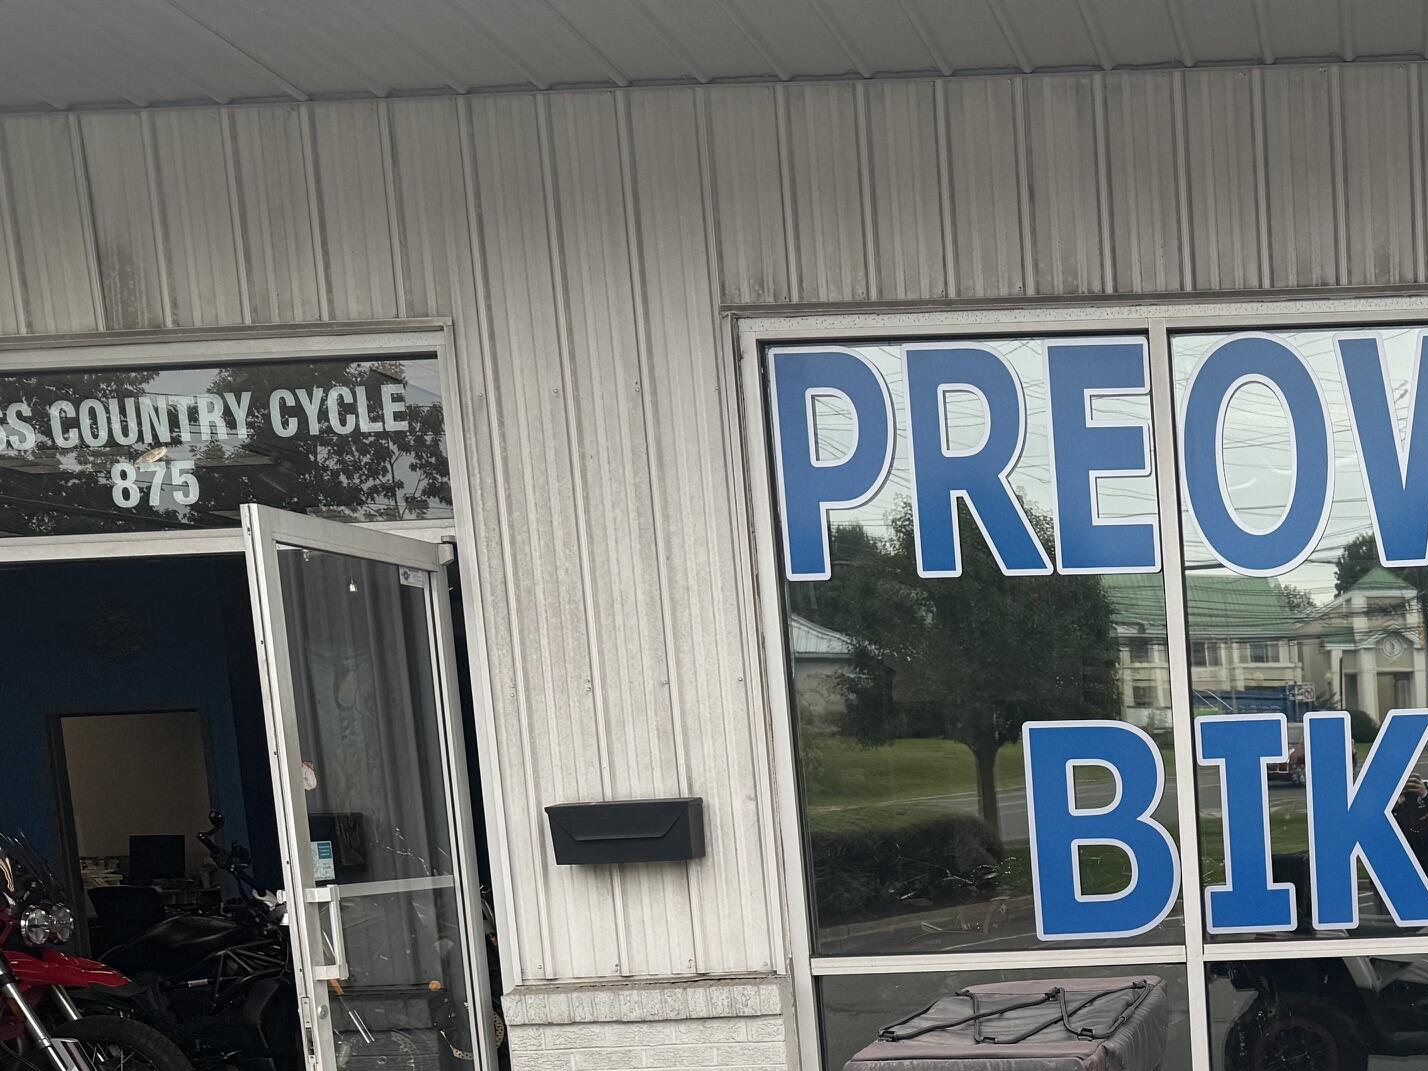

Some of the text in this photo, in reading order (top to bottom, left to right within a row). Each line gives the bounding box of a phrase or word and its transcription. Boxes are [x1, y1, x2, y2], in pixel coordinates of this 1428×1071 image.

[50, 392, 251, 448] COUNTRY
[269, 384, 409, 437] CYCLE
[110, 460, 199, 508] 875
